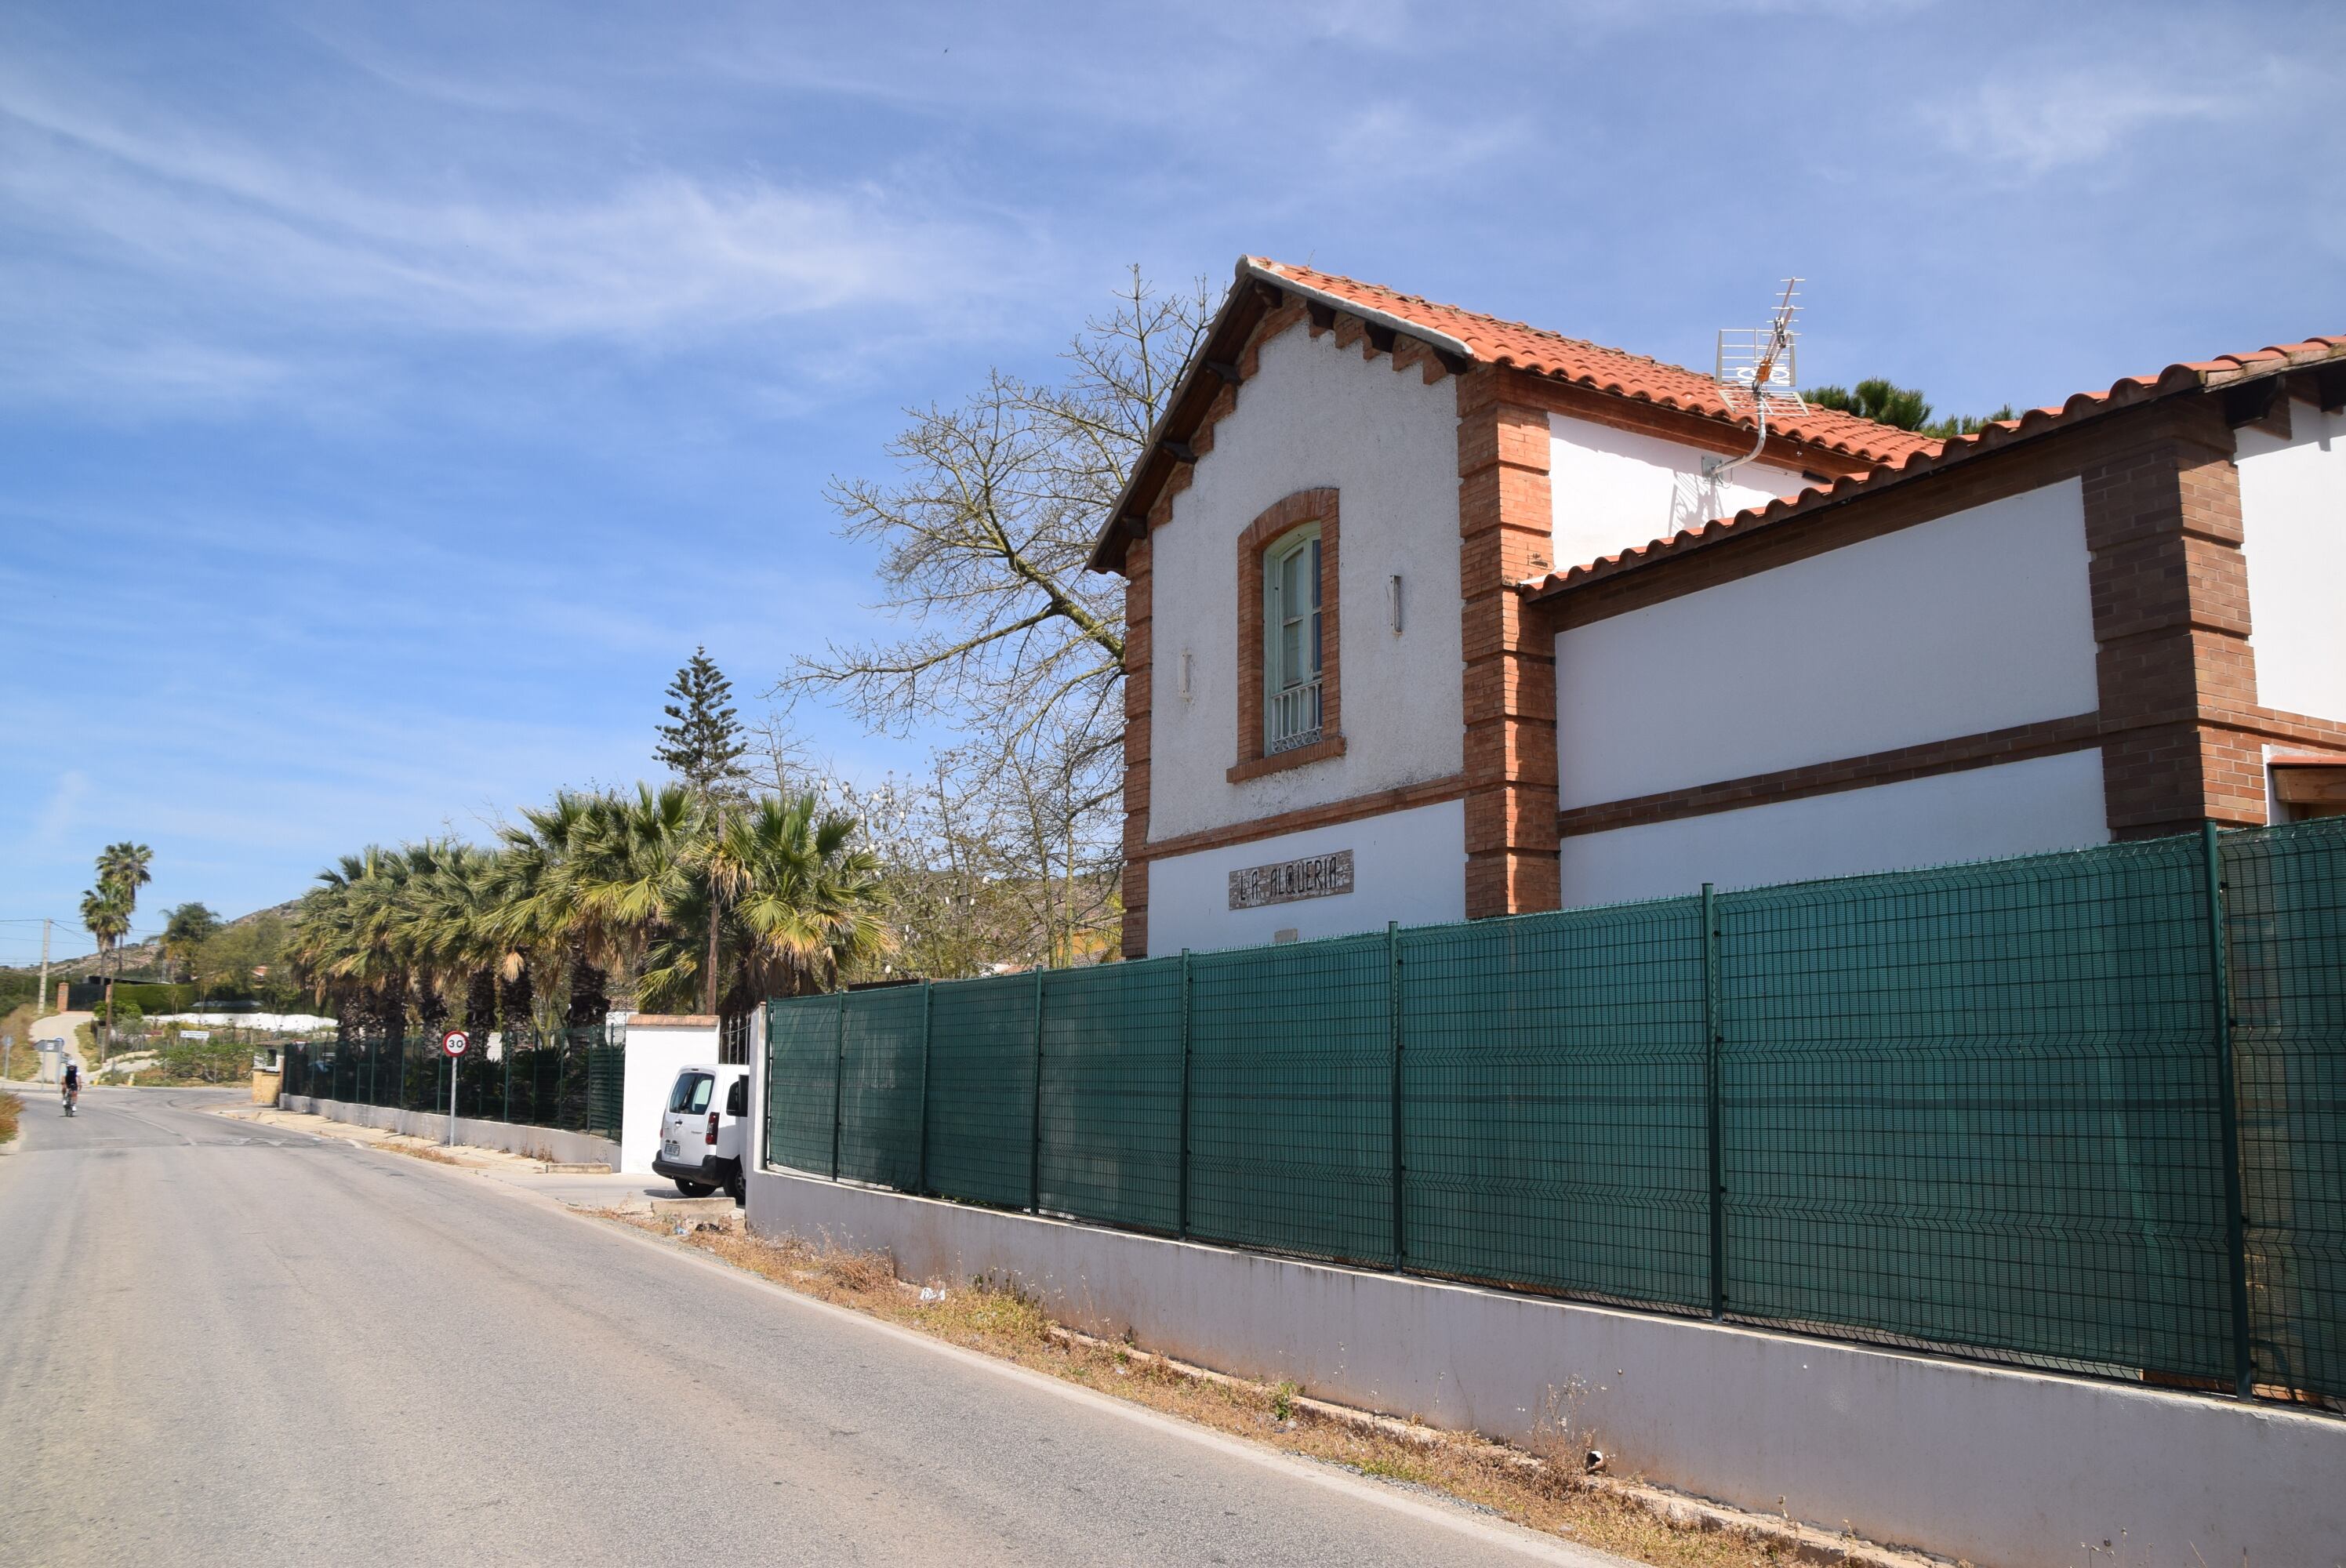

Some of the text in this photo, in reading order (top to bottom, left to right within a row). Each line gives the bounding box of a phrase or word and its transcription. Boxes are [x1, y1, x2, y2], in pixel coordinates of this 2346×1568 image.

[1240, 857, 1337, 901] LA ALQUERIA
[448, 1040, 463, 1048] 30
